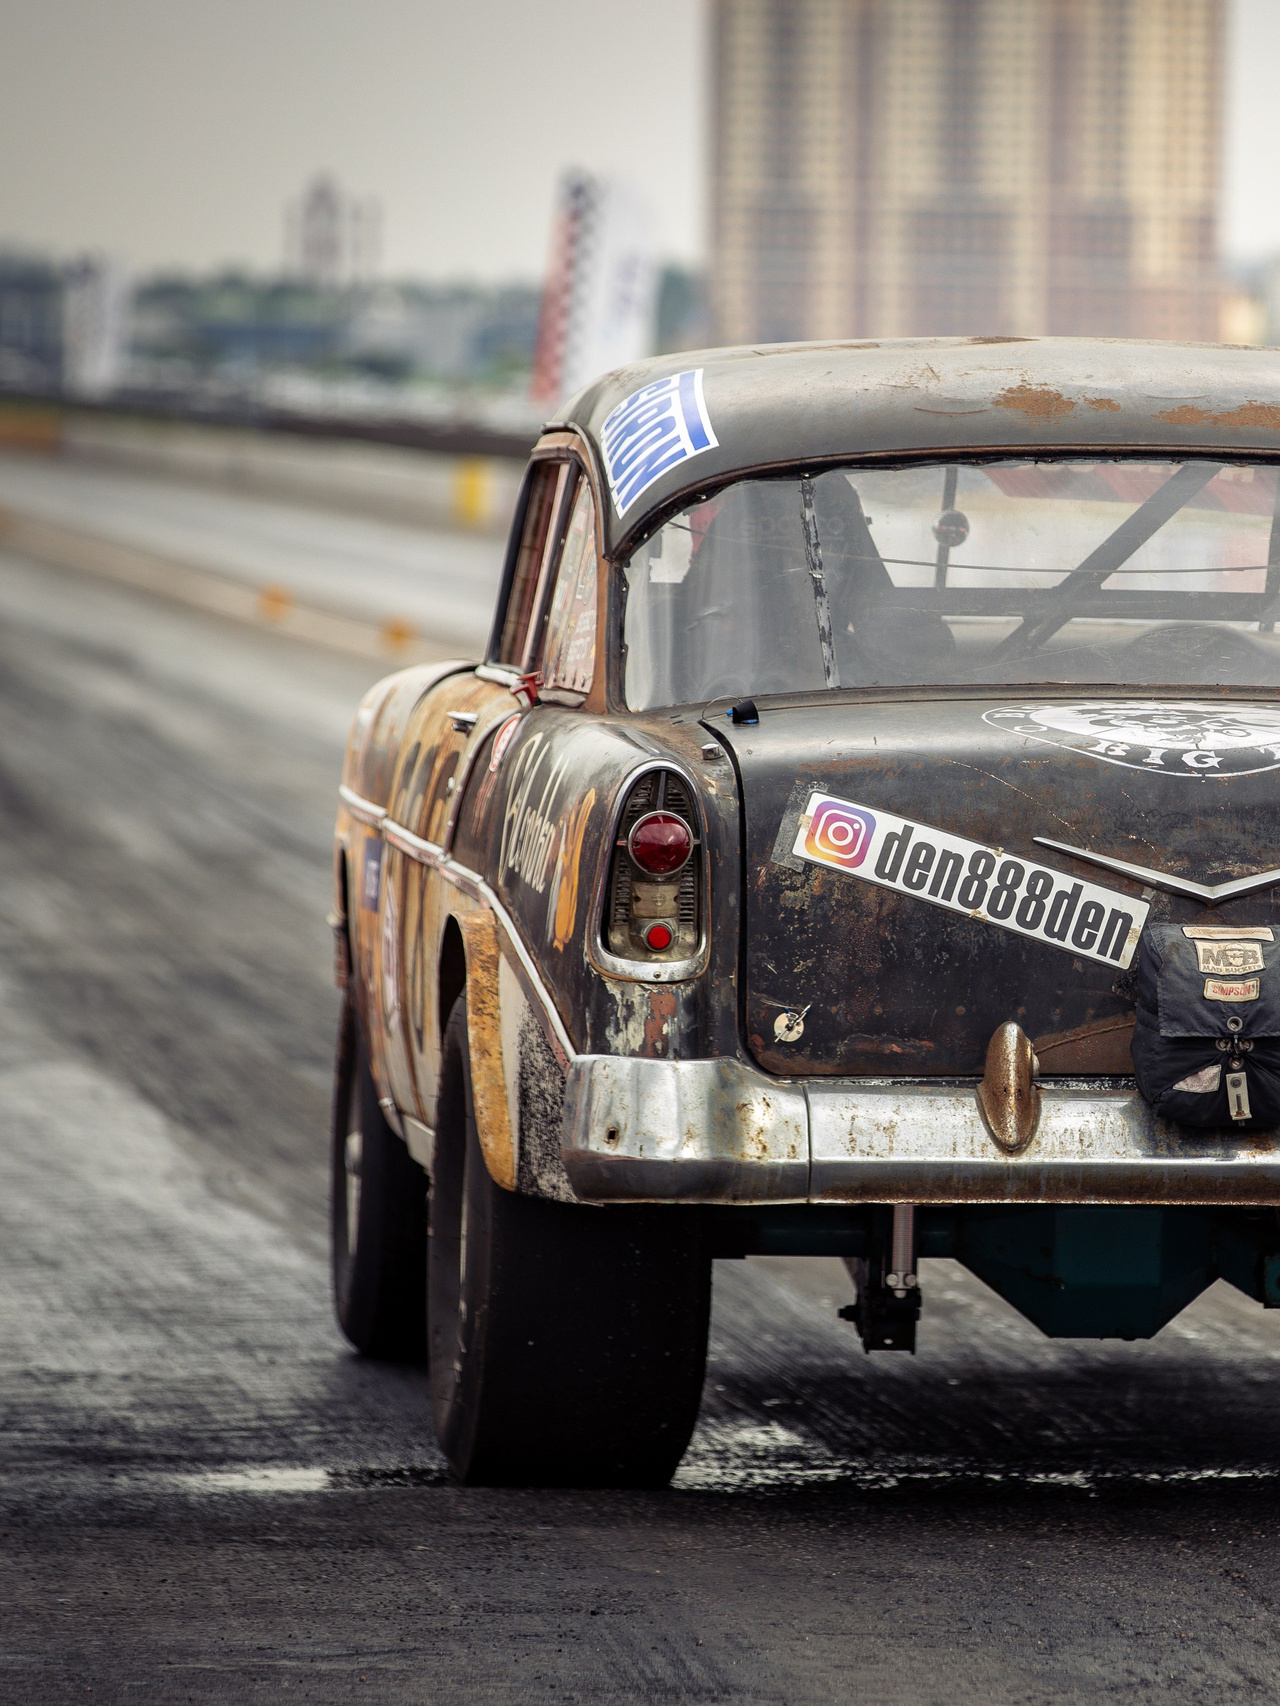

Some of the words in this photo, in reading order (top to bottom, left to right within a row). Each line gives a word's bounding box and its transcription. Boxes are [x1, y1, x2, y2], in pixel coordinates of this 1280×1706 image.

[1087, 739, 1224, 768] BIG
[874, 825, 1134, 962] den888den
[1203, 965, 1222, 973] MAD
[1212, 984, 1252, 996] SIMPSON
